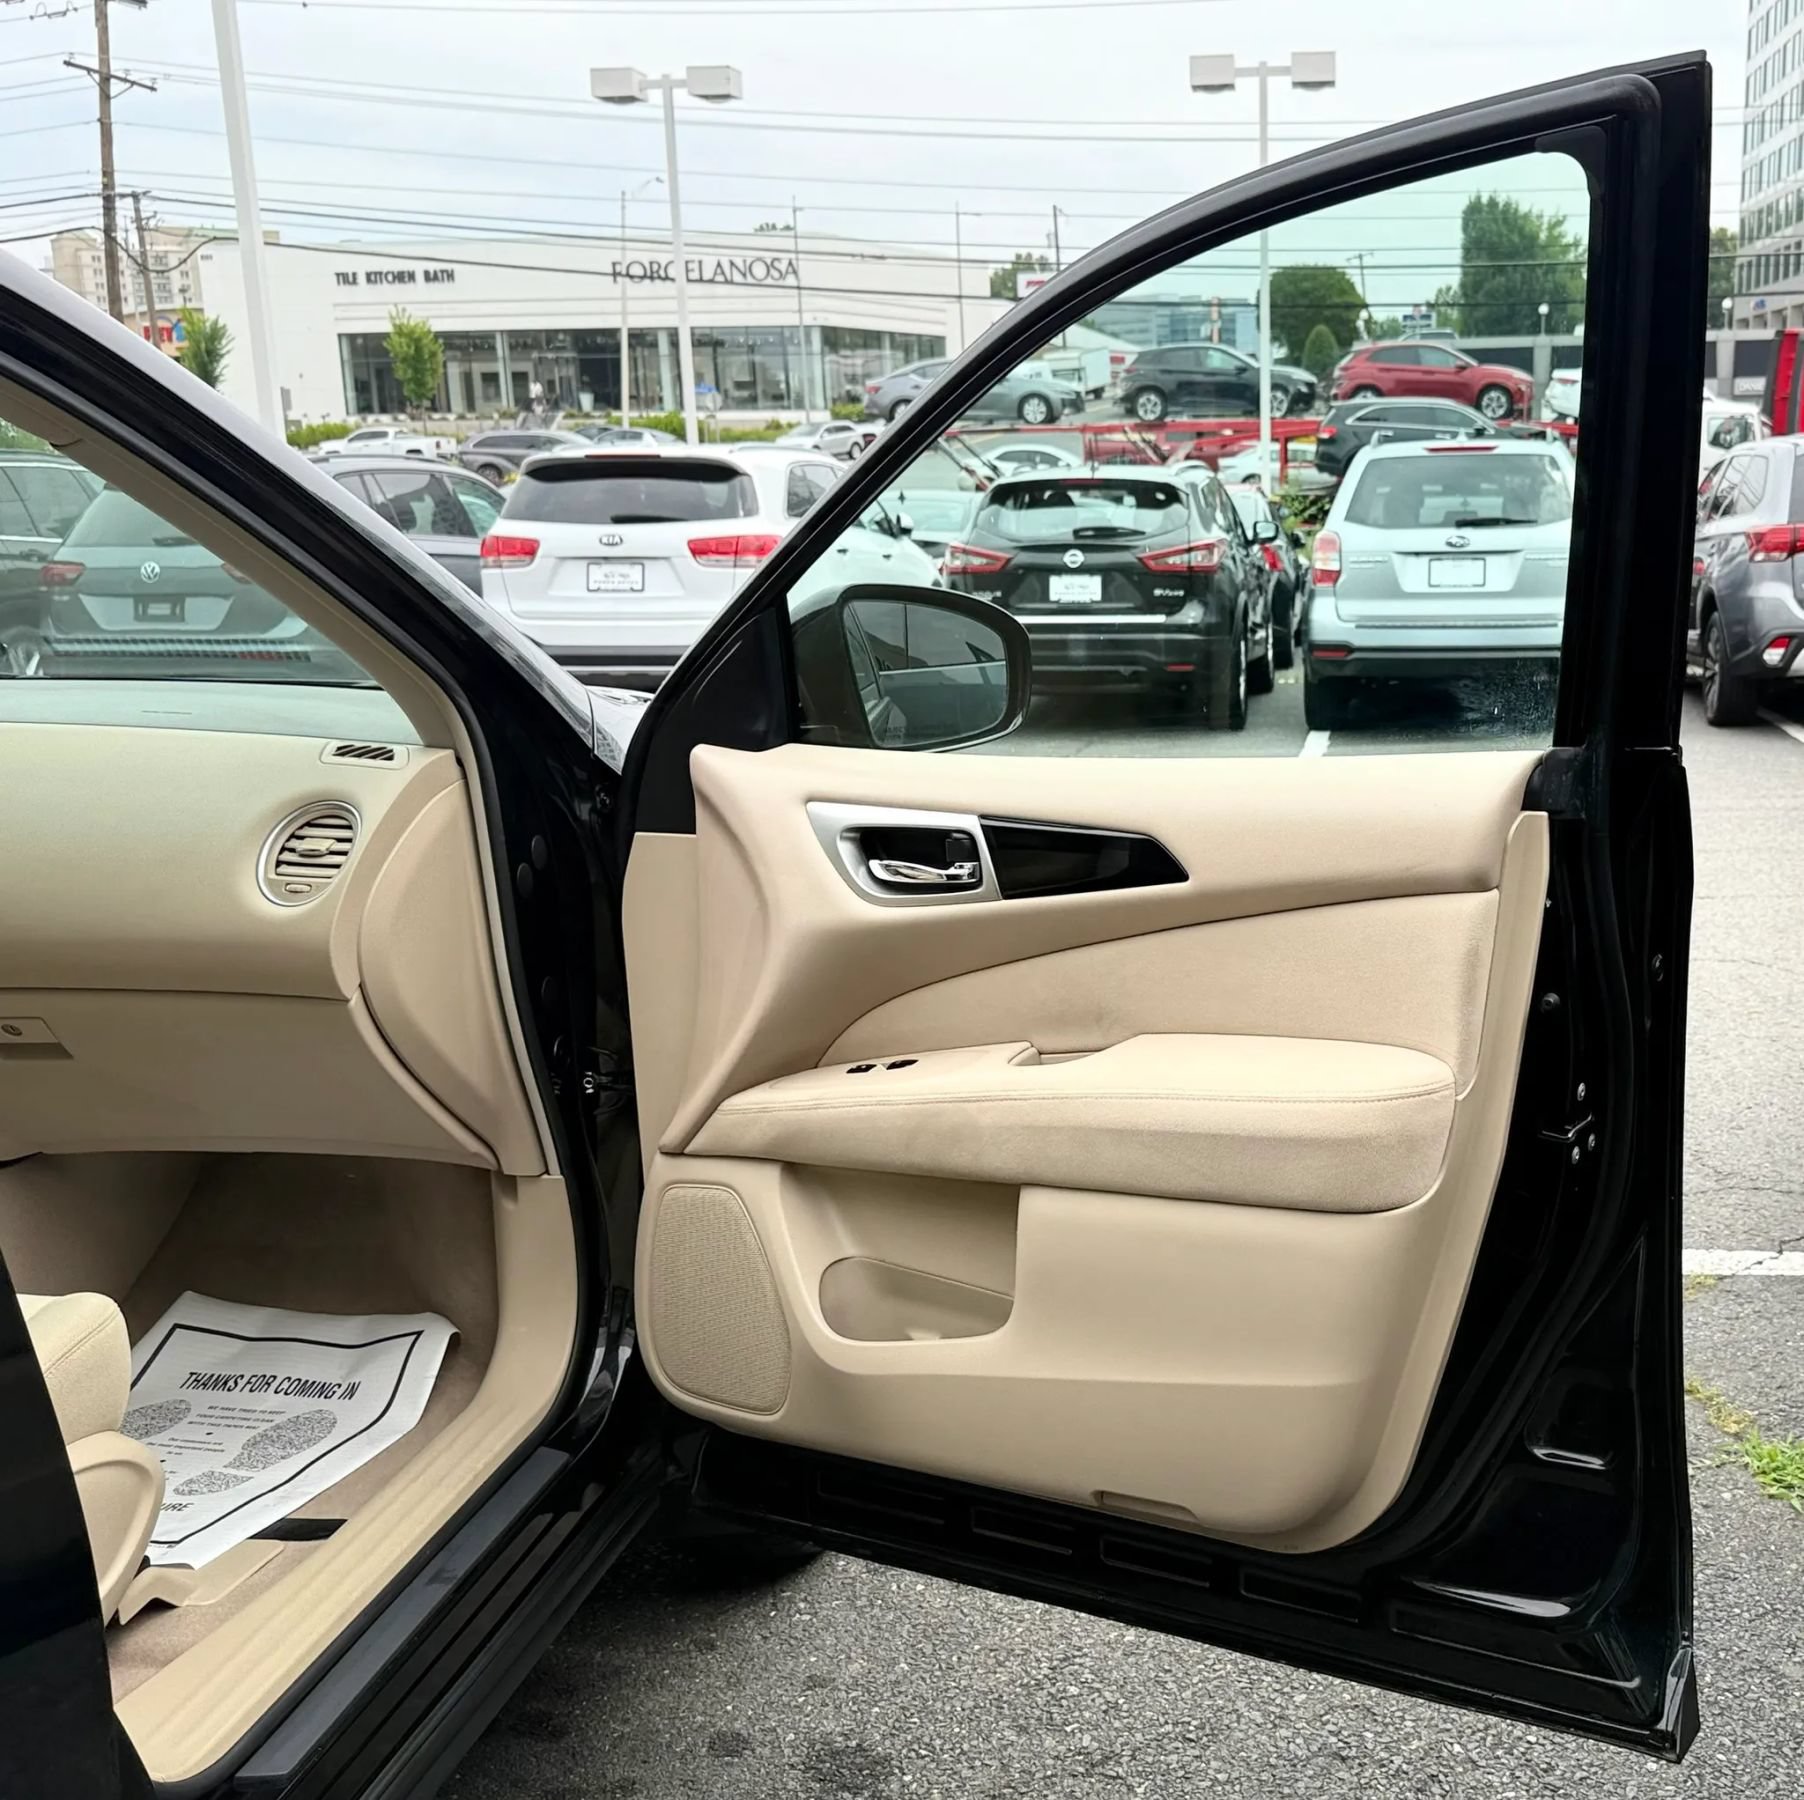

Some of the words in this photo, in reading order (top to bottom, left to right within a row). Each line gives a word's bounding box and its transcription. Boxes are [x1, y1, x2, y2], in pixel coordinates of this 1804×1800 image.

[334, 272, 358, 286] TILE
[365, 270, 416, 285] KITCHEN
[423, 269, 455, 283] BATH
[601, 535, 621, 545] KIA
[179, 1371, 245, 1393] THANKS
[239, 1374, 278, 1393] FOR
[273, 1376, 342, 1400] COMING
[337, 1381, 361, 1400] IN
